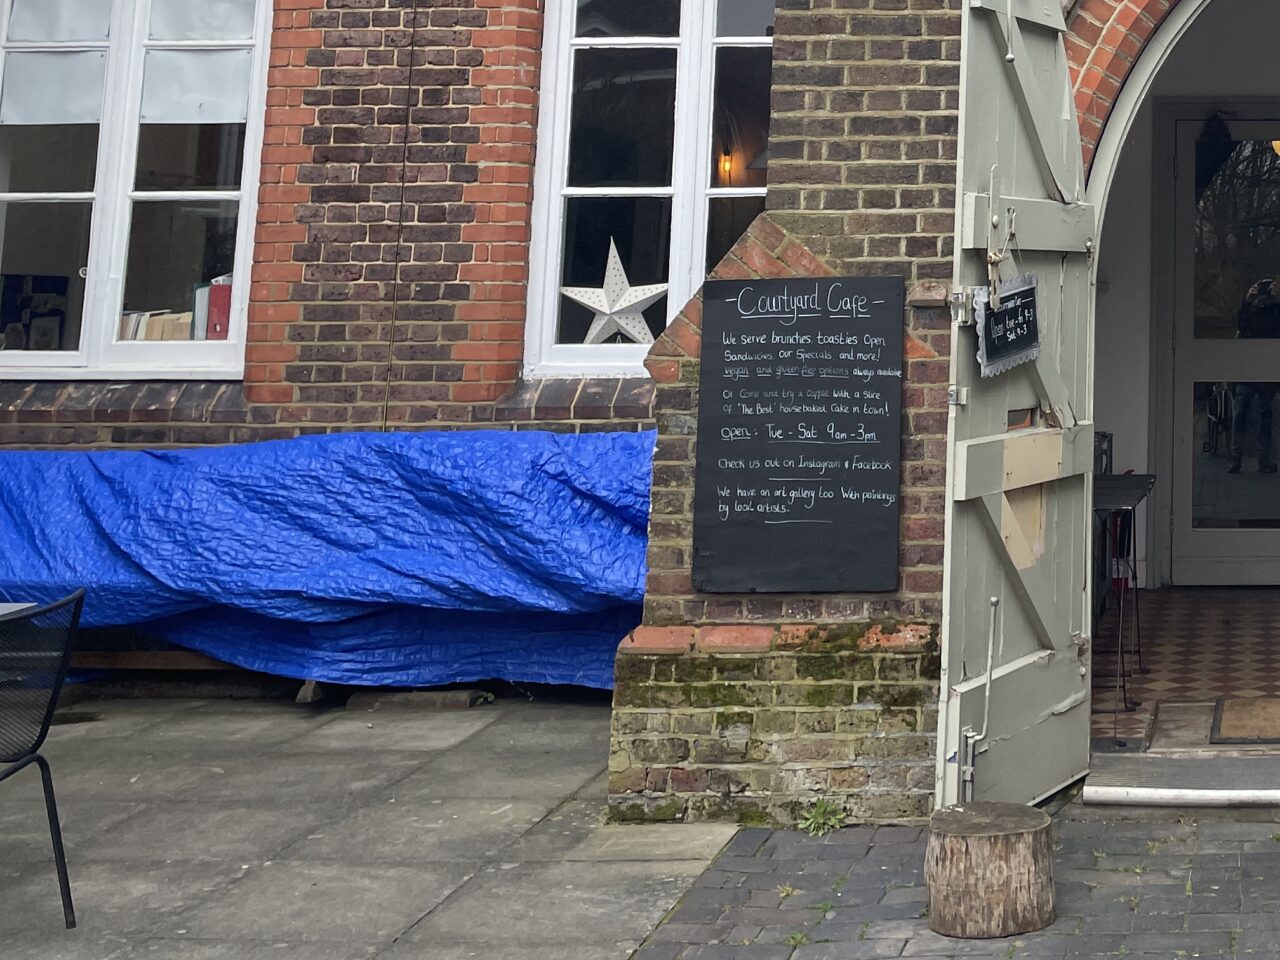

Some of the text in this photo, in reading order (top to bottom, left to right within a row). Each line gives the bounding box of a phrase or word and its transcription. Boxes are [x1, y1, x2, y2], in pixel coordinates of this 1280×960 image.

[737, 282, 869, 326] Courtyard Cafe
[722, 331, 736, 345] We
[741, 334, 767, 344] serve
[816, 331, 858, 345] toasties
[863, 334, 886, 348] Open
[779, 349, 792, 359] our
[839, 348, 855, 360] and
[857, 348, 881, 362] more!
[756, 366, 772, 376] and
[776, 365, 800, 379] gluten
[801, 365, 816, 377] free
[819, 366, 849, 378] options
[853, 367, 875, 382] always
[763, 389, 778, 398] and
[782, 390, 796, 404] try
[852, 405, 860, 413] in
[766, 423, 784, 438] Tue
[798, 423, 818, 438] Sat
[718, 458, 745, 469] Check
[749, 460, 760, 469] us
[764, 459, 781, 468] out
[783, 460, 795, 468] on
[798, 455, 841, 474] Instagram
[852, 455, 892, 471] Facebook
[717, 485, 731, 497] We
[736, 485, 756, 497] have
[760, 489, 771, 497] an
[774, 486, 787, 497] art
[789, 487, 815, 509] gallery
[818, 486, 835, 498] too
[861, 489, 897, 507] paintings
[718, 499, 729, 521] by
